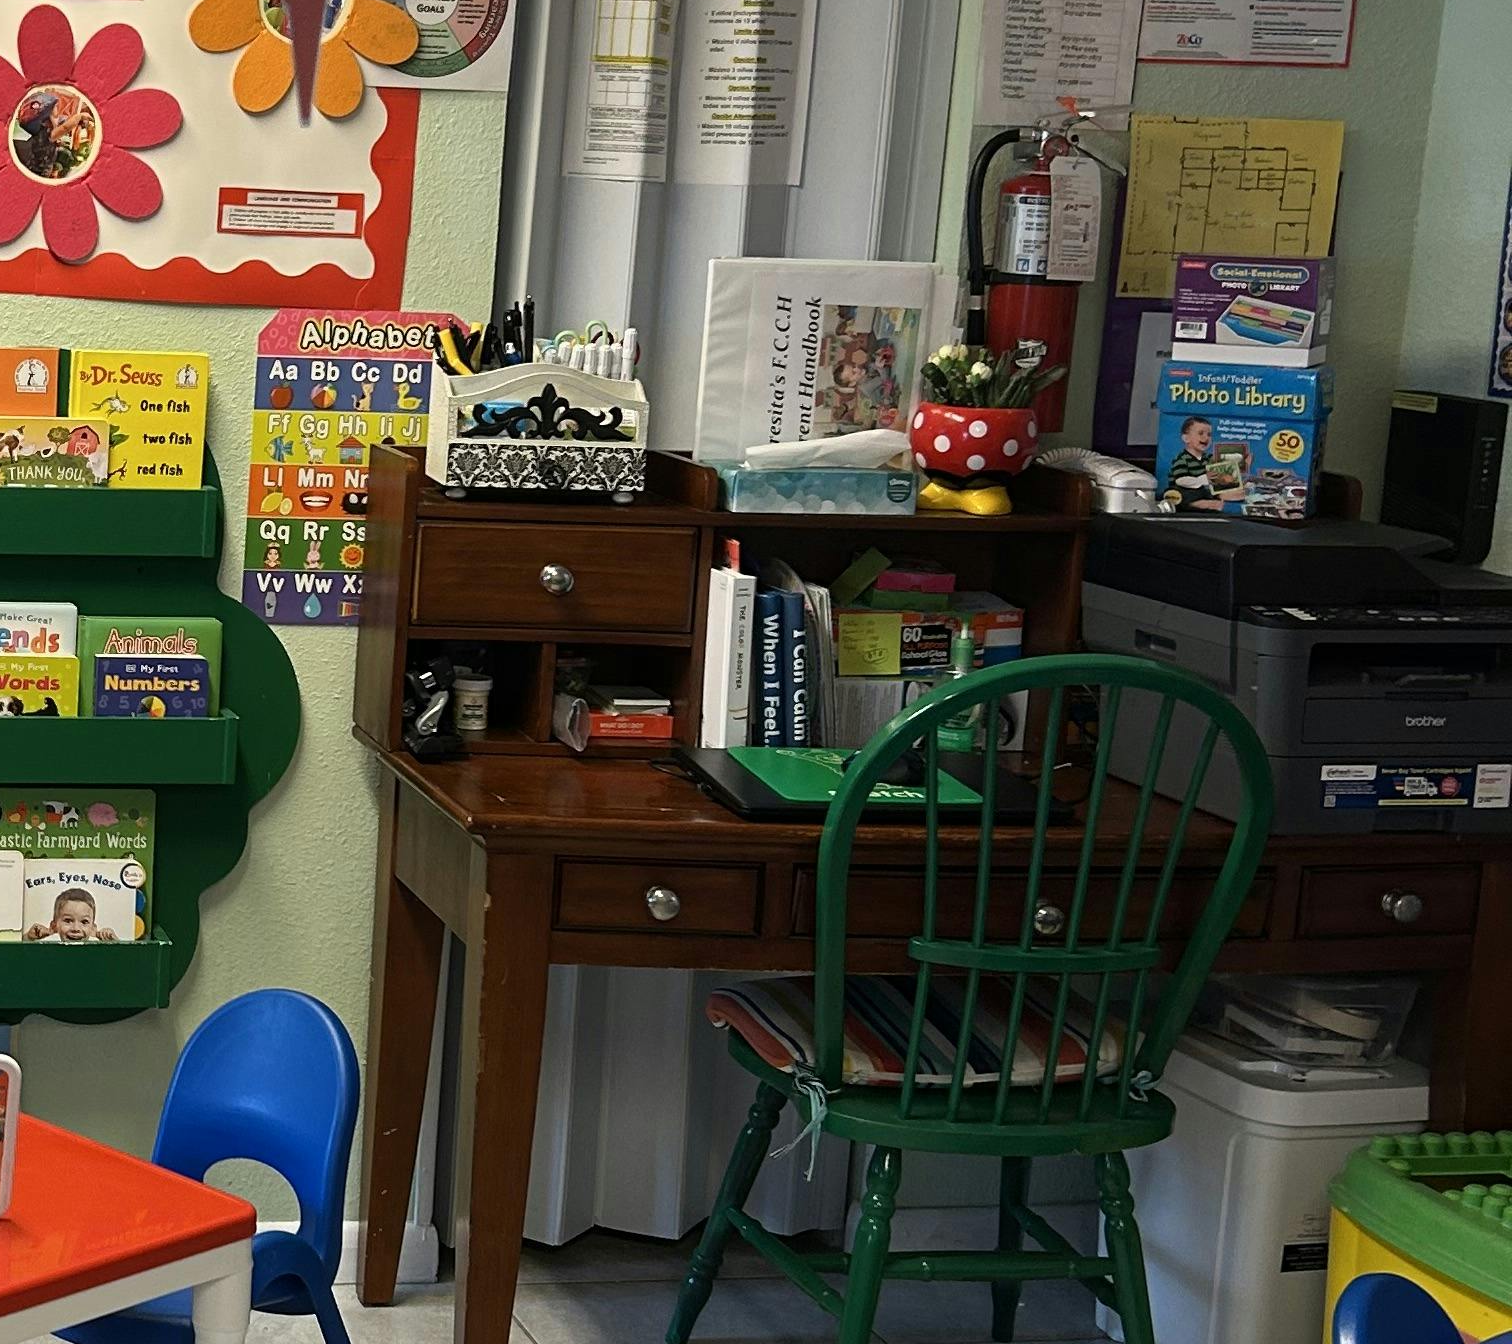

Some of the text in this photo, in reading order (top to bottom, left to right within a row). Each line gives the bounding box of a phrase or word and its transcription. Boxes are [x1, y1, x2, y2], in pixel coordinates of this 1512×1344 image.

[417, 4, 444, 14] GOALS
[1217, 267, 1302, 279] Social-Emotional
[1222, 282, 1300, 292] PHOTO LIBRARY
[300, 318, 439, 352] Alphabet
[772, 296, 792, 370] F.C.C.H
[799, 296, 822, 399] Handbook
[79, 363, 163, 387] By Dr. Seuss
[268, 360, 423, 383] Aa Bb Cc Dd
[1198, 373, 1263, 385] Infant/Toddler
[1169, 381, 1306, 414] Photo Library
[140, 399, 191, 413] One fish
[143, 432, 192, 446] two fish
[1276, 432, 1300, 448] 50
[137, 463, 183, 476] red fish
[0, 613, 23, 622] Make
[26, 615, 53, 625] Great
[104, 628, 198, 654] Animals
[903, 627, 922, 642] 60
[763, 614, 780, 689] When I
[140, 664, 179, 674] My First
[104, 675, 200, 691] Numbers
[793, 629, 807, 741] I Can Calm
[1404, 714, 1446, 729] brother
[37, 832, 100, 851] Farmyard
[106, 833, 147, 849] Words
[26, 872, 122, 890] Ears, Eyes, Nose
